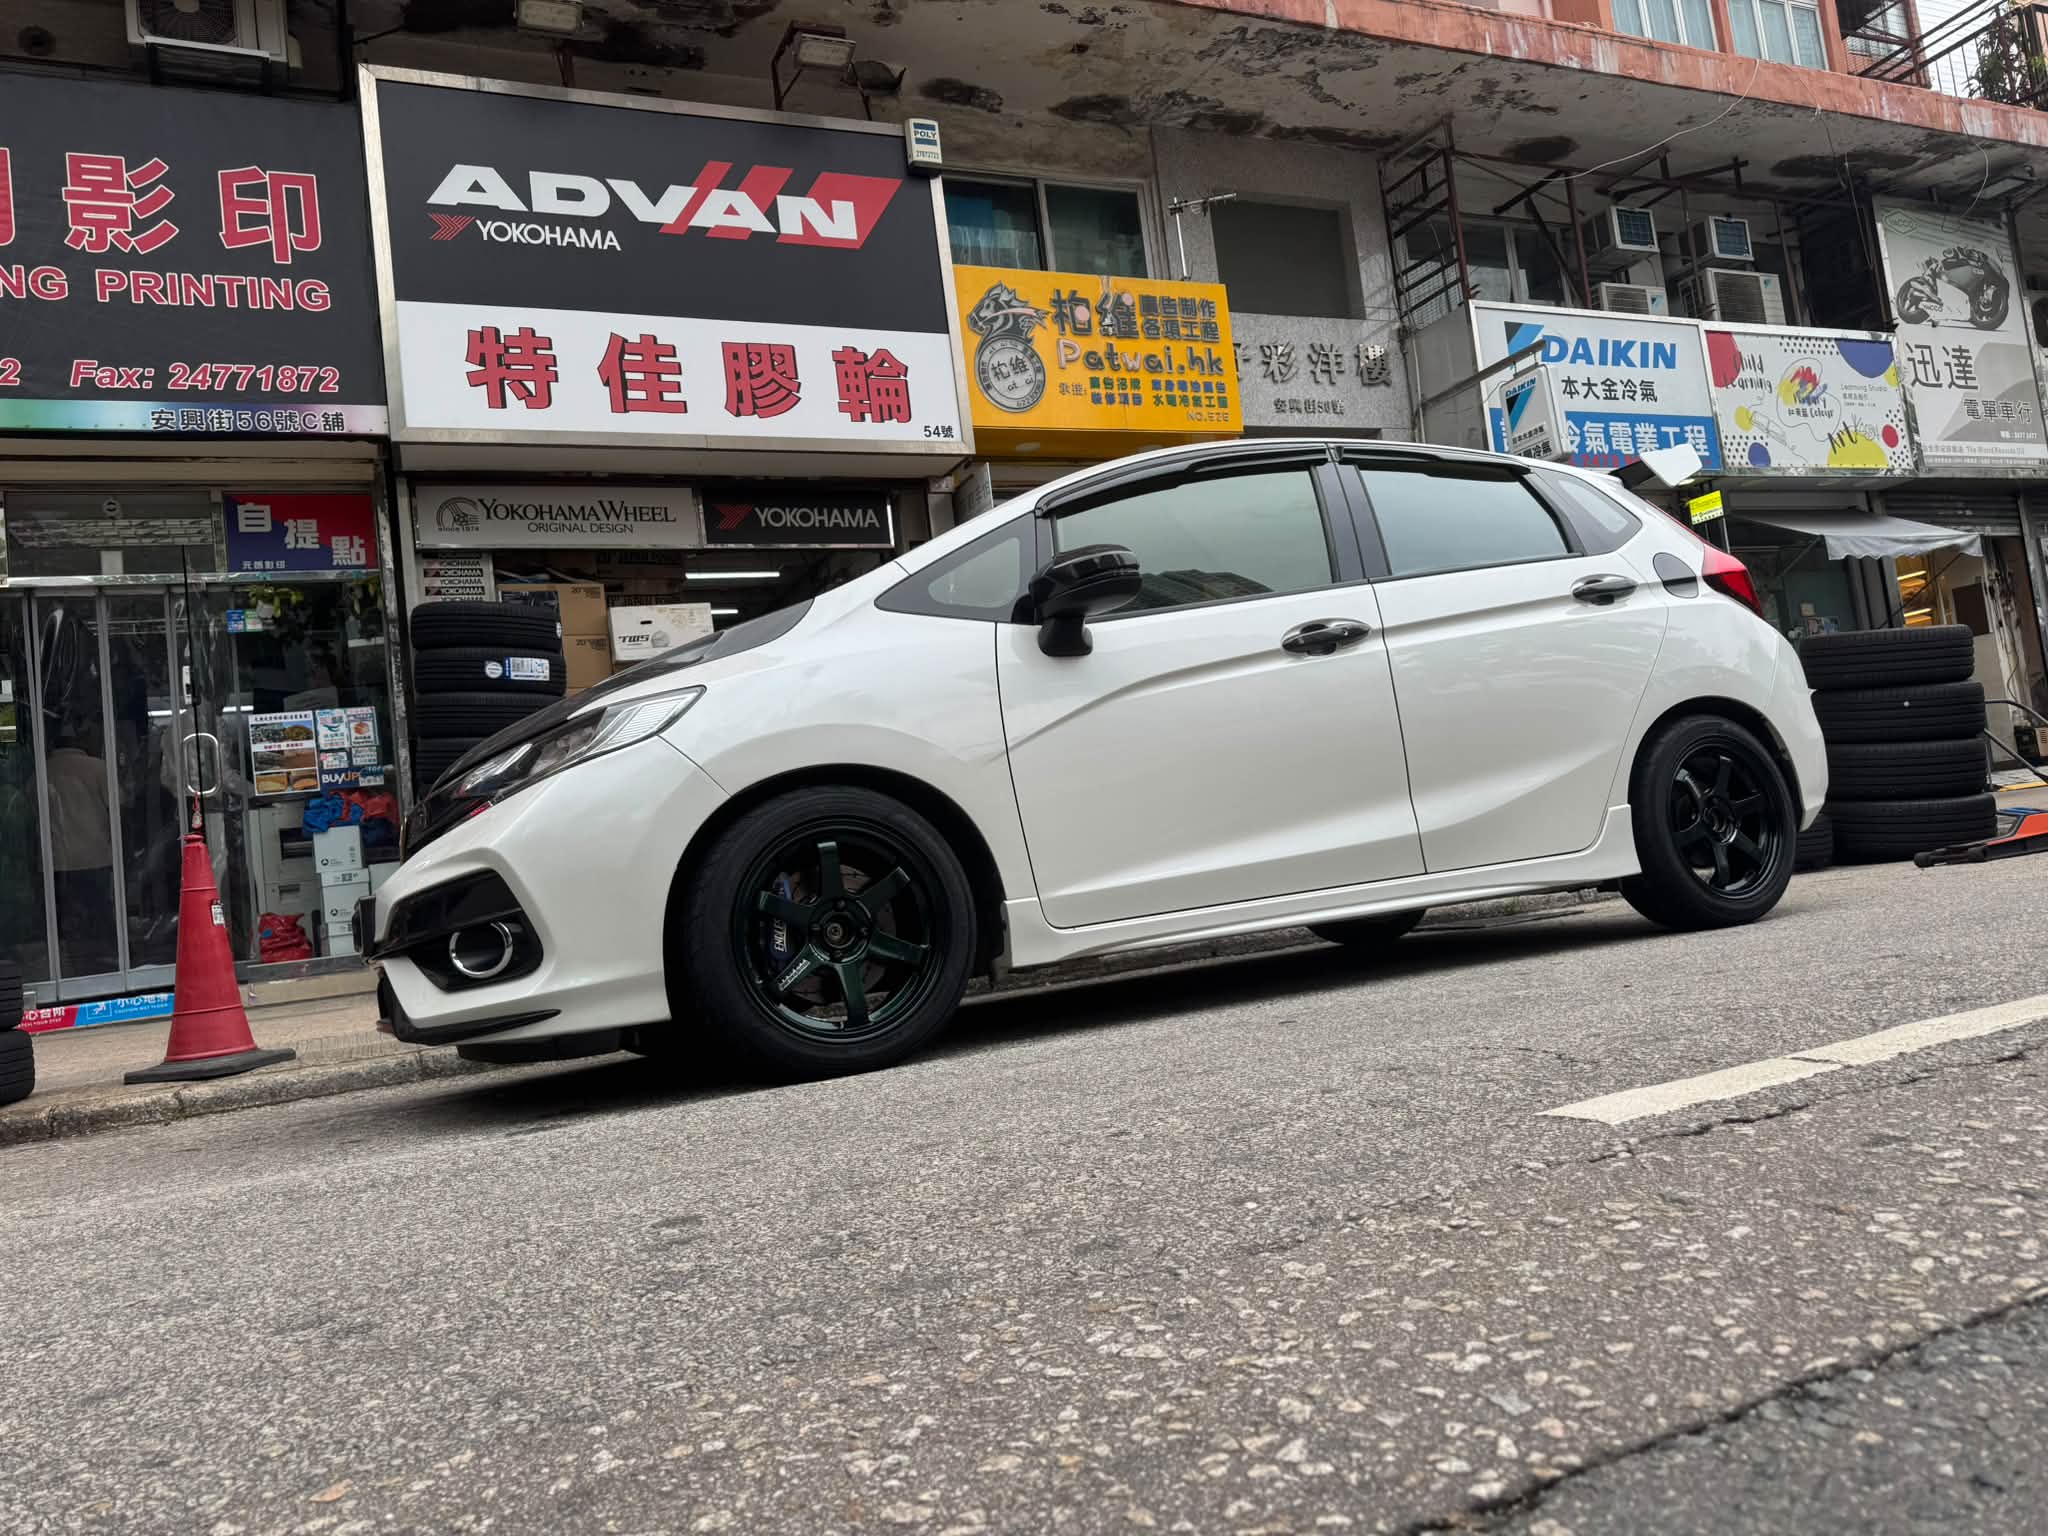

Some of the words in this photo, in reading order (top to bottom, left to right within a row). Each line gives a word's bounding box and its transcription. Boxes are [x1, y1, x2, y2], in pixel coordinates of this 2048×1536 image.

[0, 148, 322, 264] 影印
[426, 164, 858, 240] ADVAN
[475, 218, 621, 251] YOKOHAMA
[95, 268, 331, 311] PRINTING
[1541, 334, 1677, 369] DAIKIN
[1905, 342, 1979, 390] 迅達
[70, 359, 155, 389] Fax:
[167, 362, 340, 393] 24771872
[465, 325, 911, 424] 特佳膠輪
[1505, 376, 1537, 397] DAIKIN
[151, 408, 345, 433] 安興街56號C舖
[1963, 398, 2033, 424] 電單車行
[923, 423, 955, 440] 54號
[477, 499, 596, 521] YOKOHAMA
[755, 507, 880, 528] YOKOHAMA
[237, 502, 367, 567] 自提點
[527, 522, 588, 534] ORIGINAL
[592, 523, 634, 534] DESIGN
